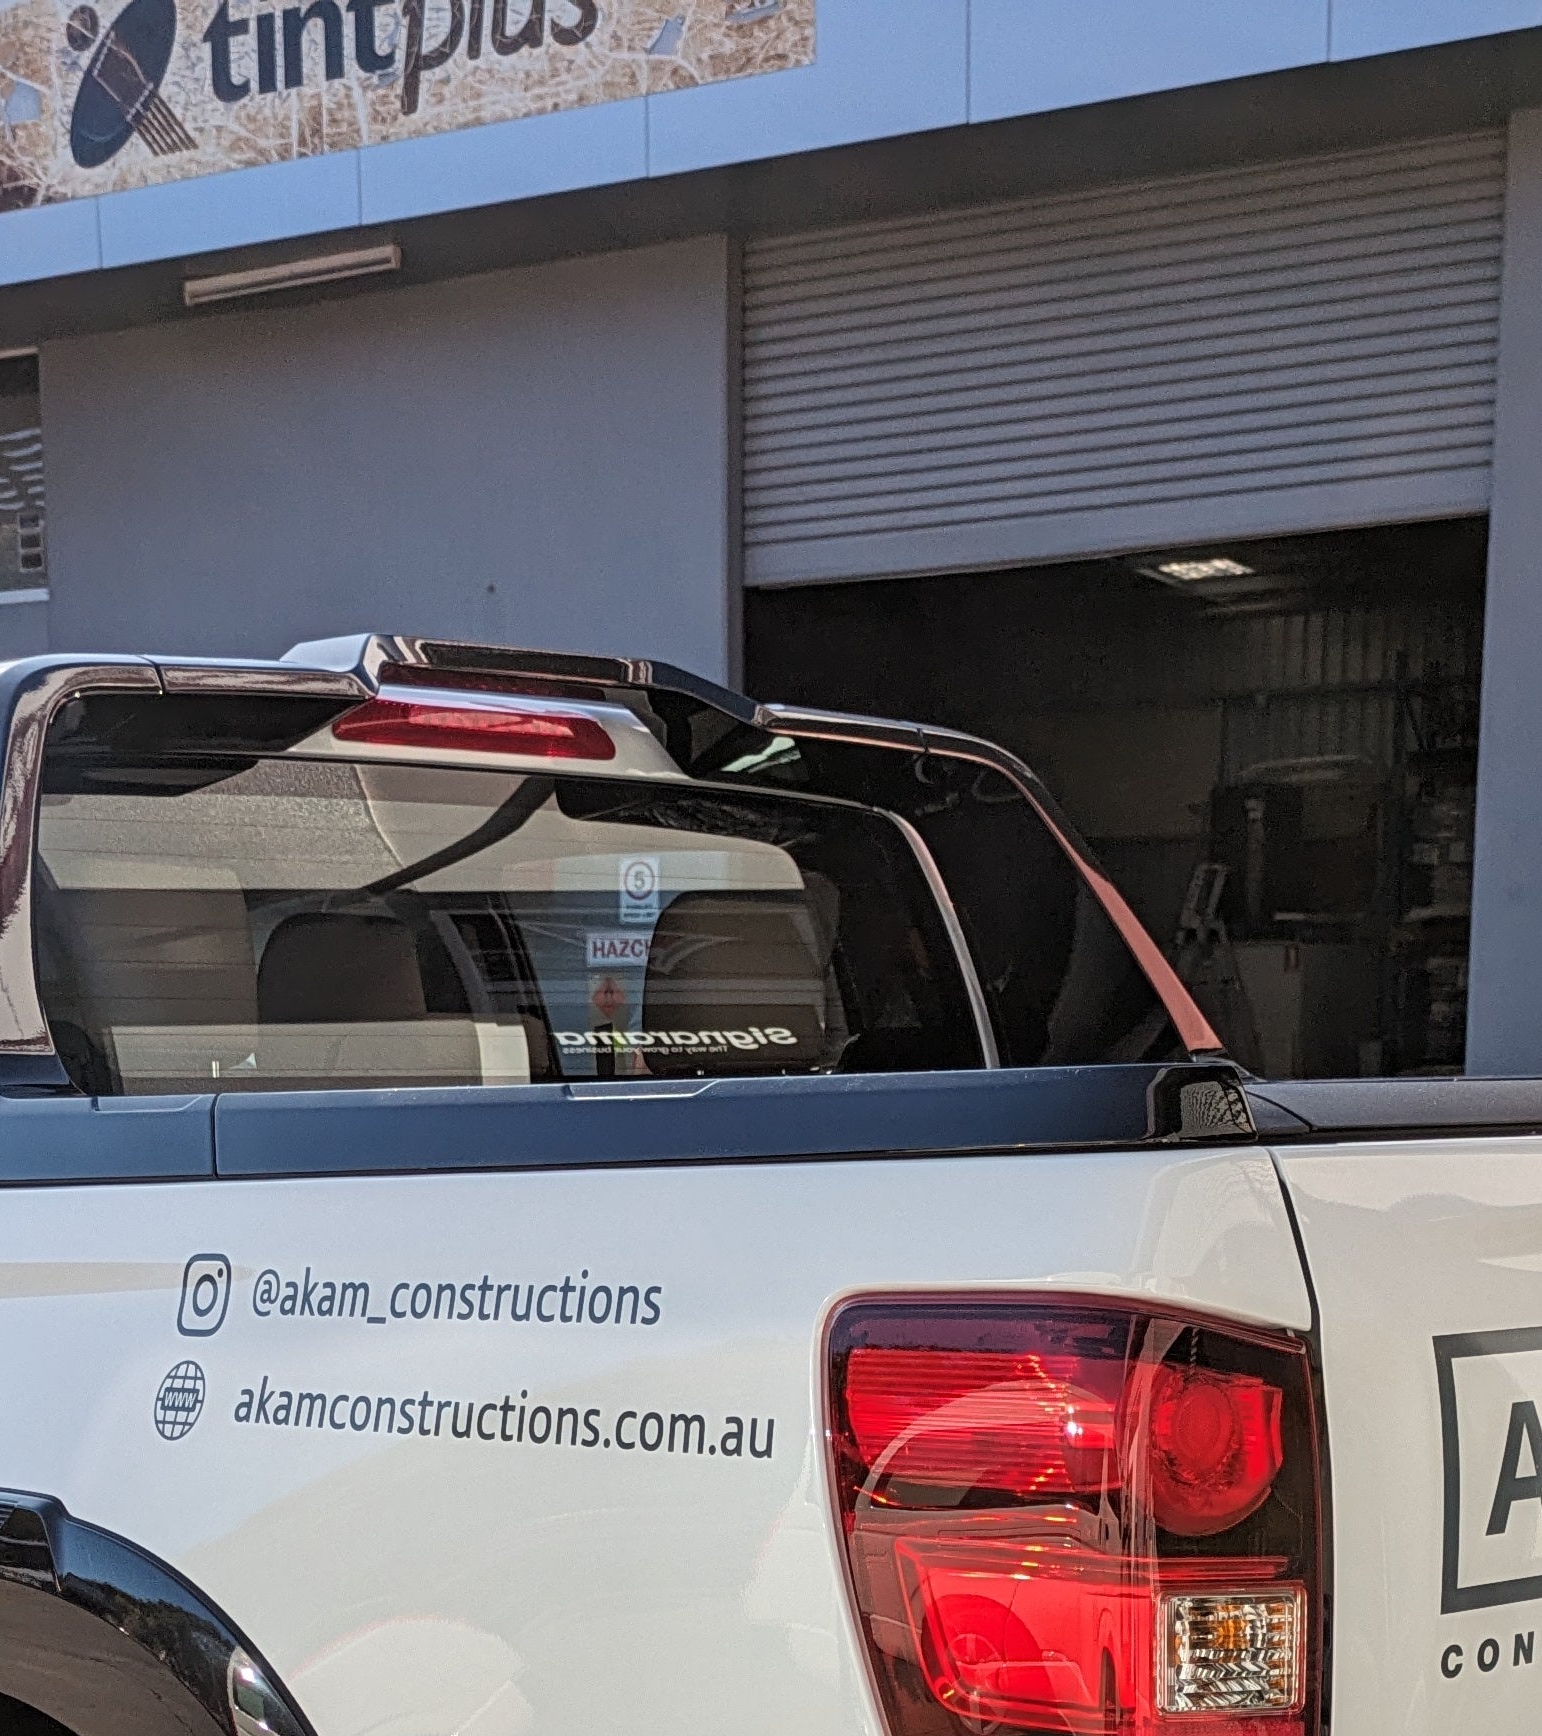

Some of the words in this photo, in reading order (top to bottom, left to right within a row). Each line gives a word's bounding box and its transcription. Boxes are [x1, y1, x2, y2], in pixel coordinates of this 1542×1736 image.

[202, 0, 599, 115] tintplus
[252, 1266, 664, 1327] @akam_constructions
[233, 1375, 777, 1459] akamconstructions.com.au
